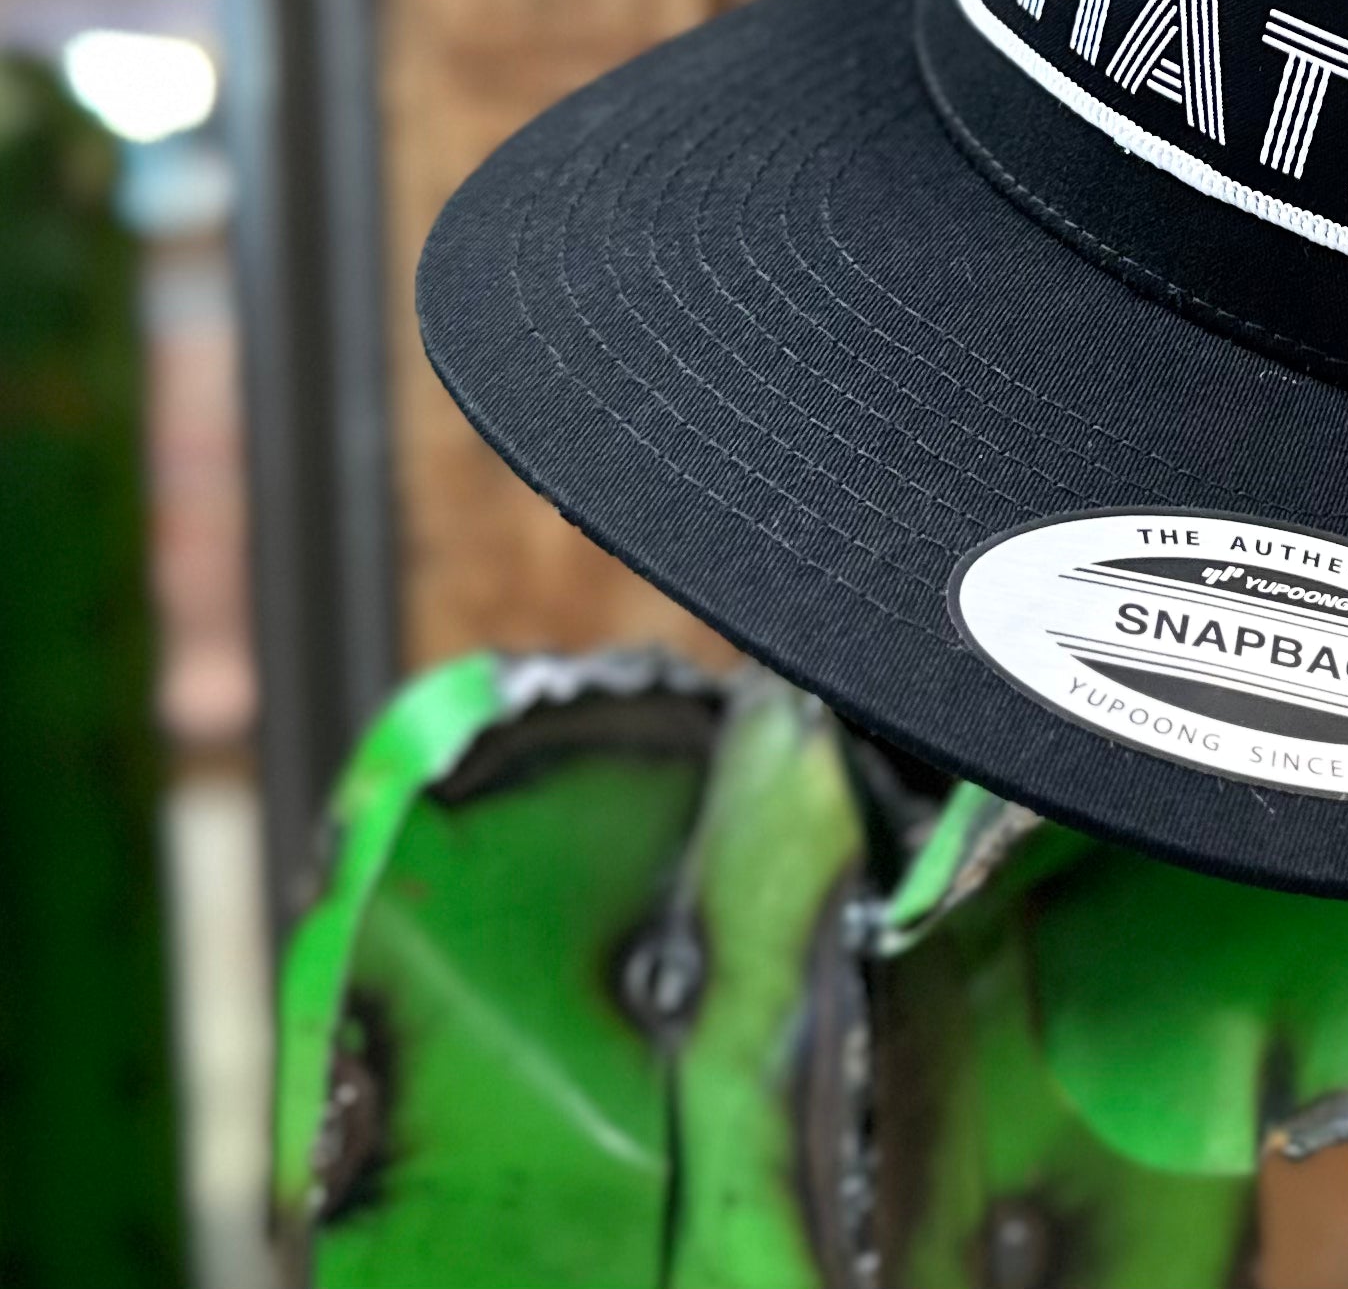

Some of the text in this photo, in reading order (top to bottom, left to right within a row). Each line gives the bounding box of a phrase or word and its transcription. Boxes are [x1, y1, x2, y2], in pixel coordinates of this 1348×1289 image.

[1137, 527, 1202, 547] THE
[1068, 676, 1222, 753] YUPOONG
[1250, 745, 1346, 779] SINCE
